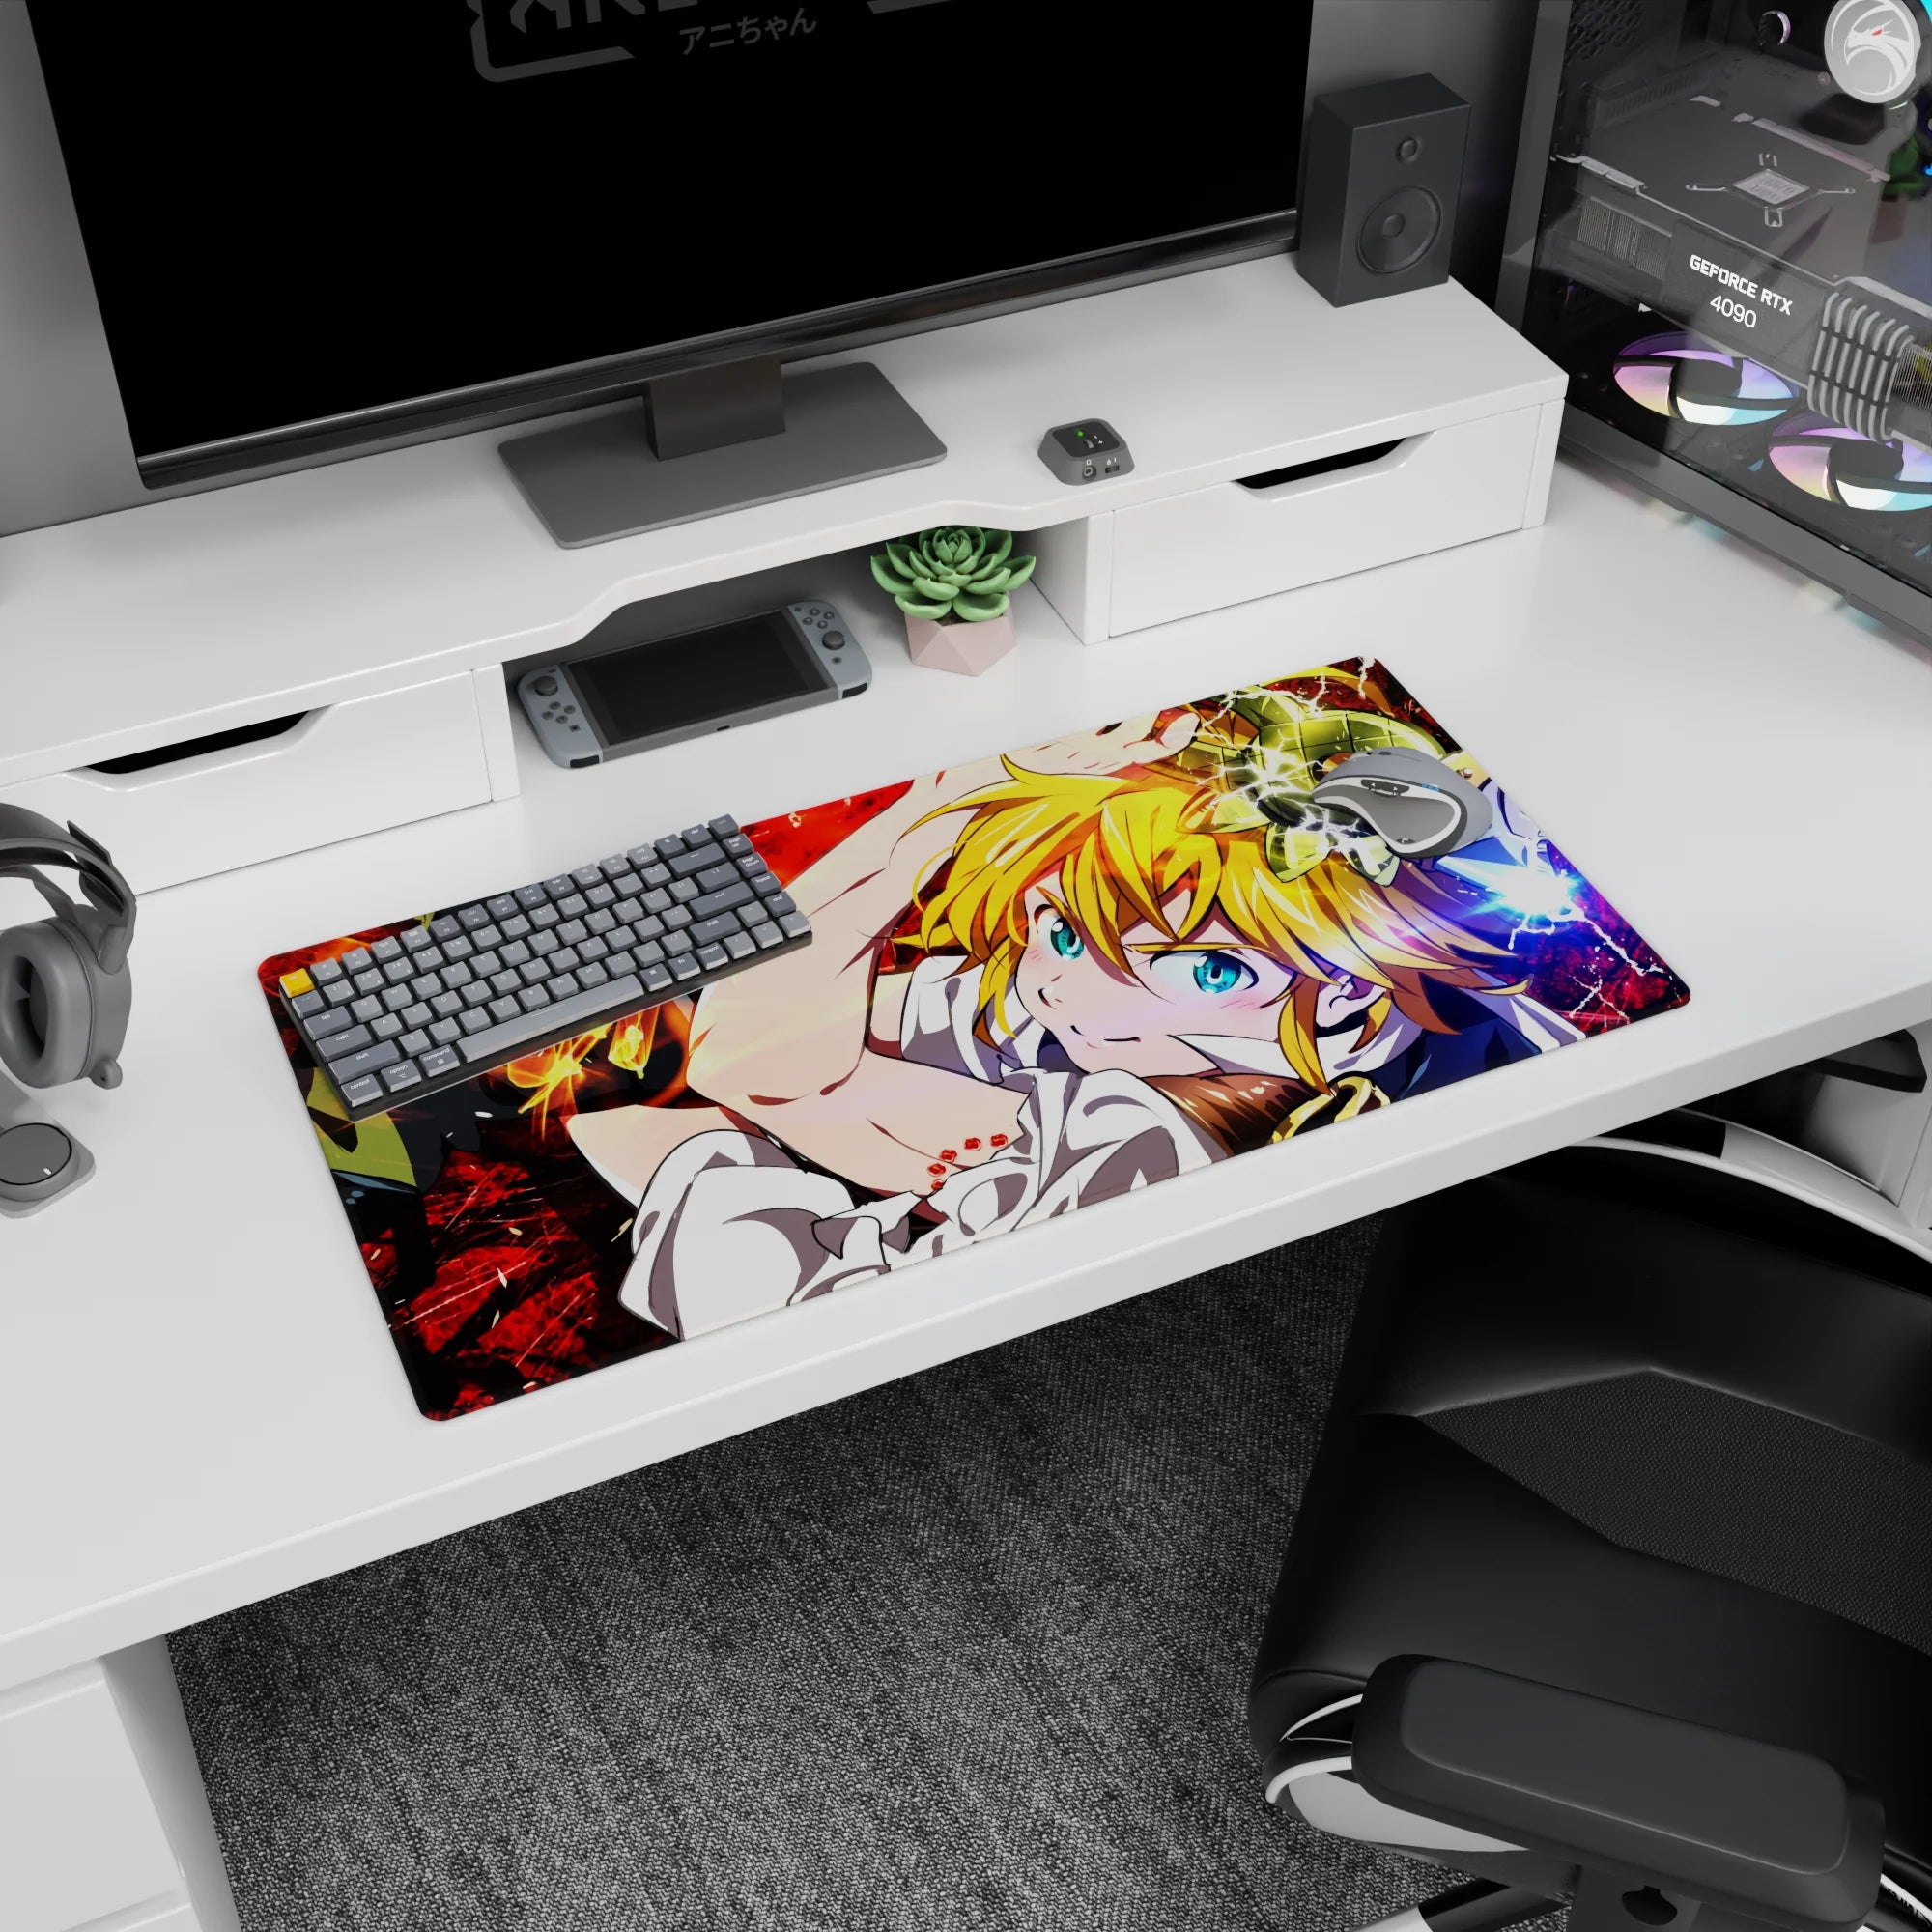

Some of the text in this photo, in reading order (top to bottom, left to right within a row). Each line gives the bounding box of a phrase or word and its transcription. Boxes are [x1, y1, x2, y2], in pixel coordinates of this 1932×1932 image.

[679, 7, 817, 56] アニちゃん
[1690, 254, 1793, 315] GEFORCE RTX
[1710, 295, 1757, 328] 4090
[423, 1047, 451, 1061] command
[389, 1065, 409, 1075] option
[350, 1079, 371, 1090] control
